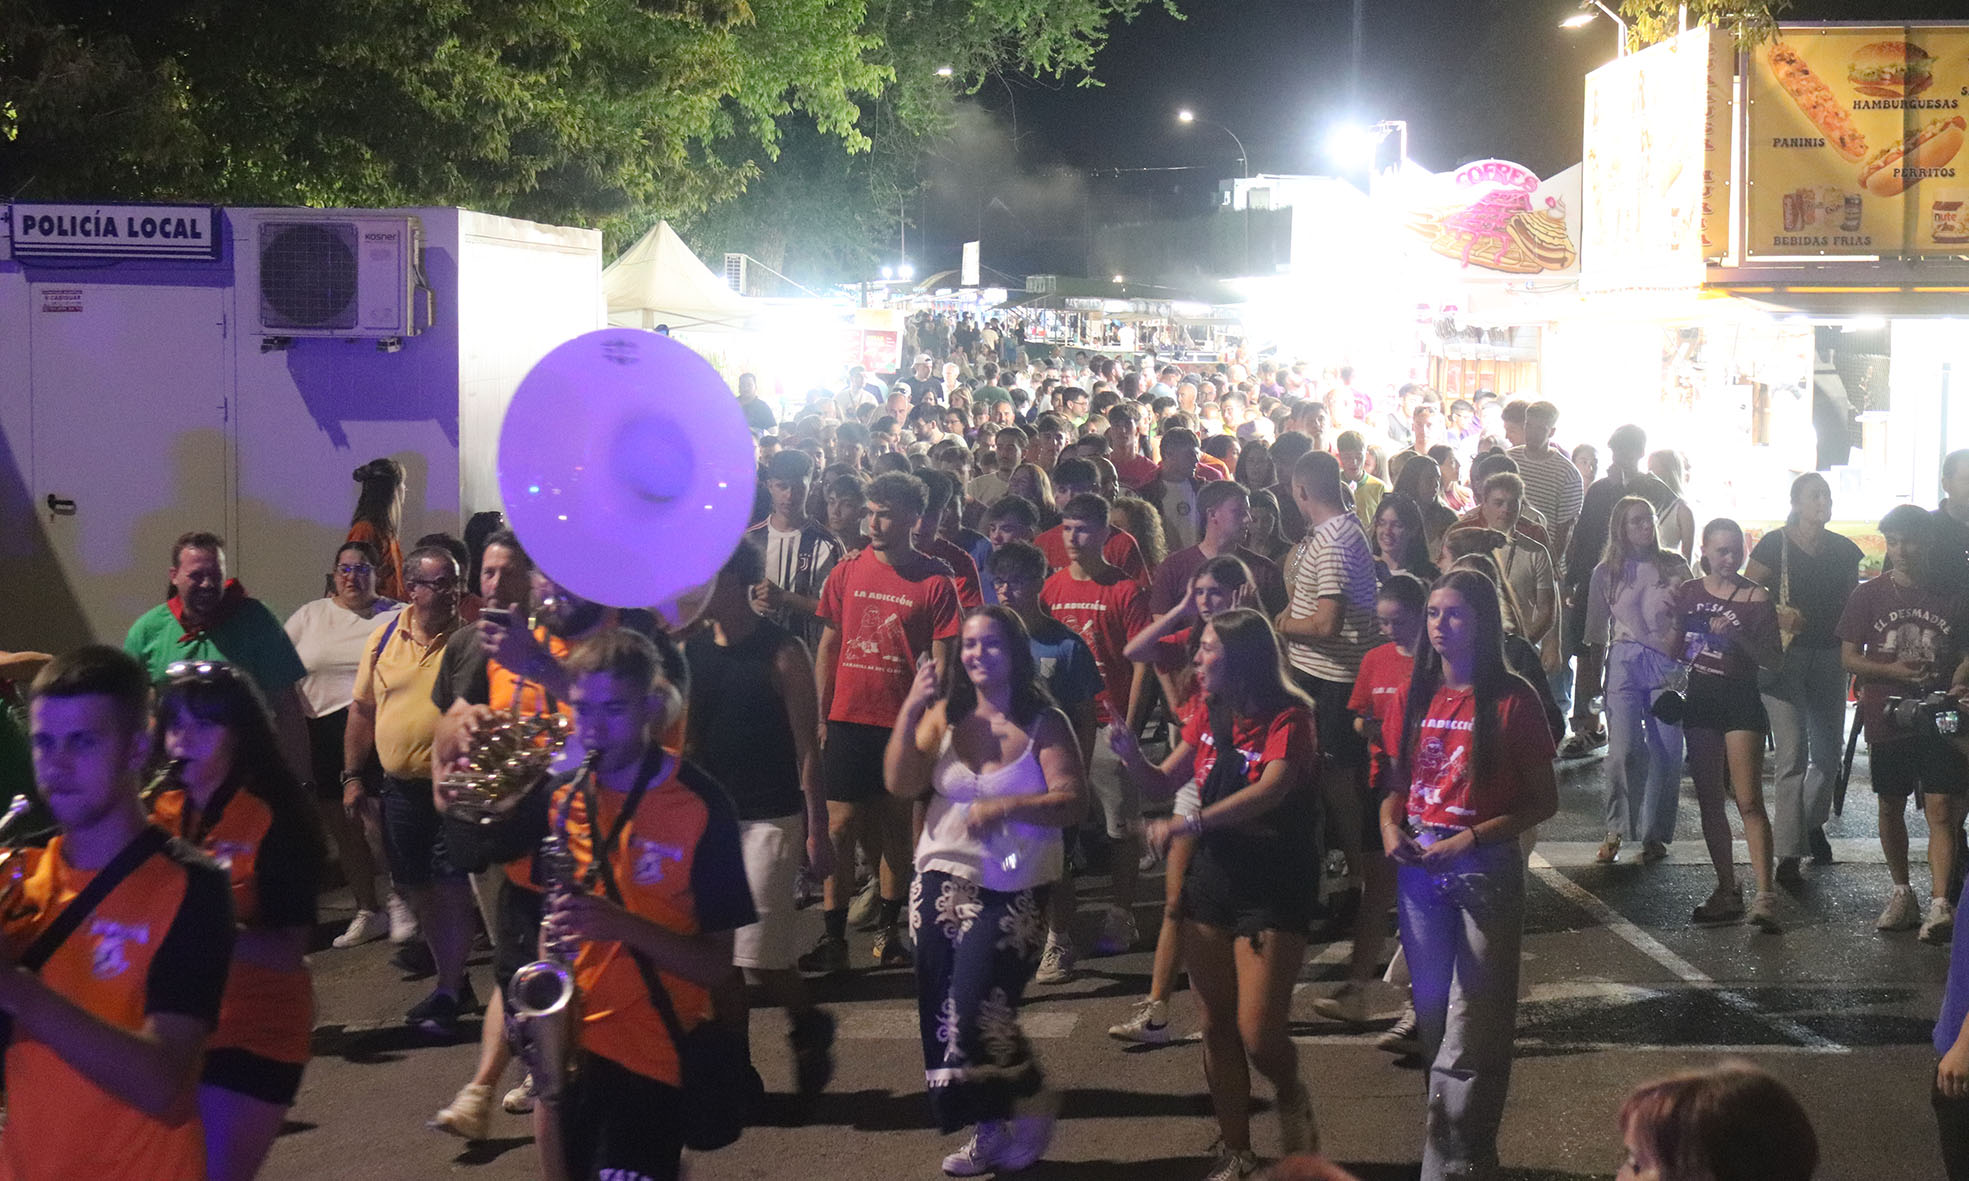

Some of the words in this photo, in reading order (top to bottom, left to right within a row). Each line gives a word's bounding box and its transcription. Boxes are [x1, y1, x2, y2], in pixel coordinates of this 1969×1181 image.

[1852, 99, 1958, 110] HAMBURGUESAS
[1772, 137, 1825, 148] PANINIS
[1893, 167, 1956, 178] PERRITOS
[22, 209, 119, 237] POLICÍA
[127, 217, 202, 239] LOCAL
[1773, 236, 1828, 246] BEBIDAS
[1833, 236, 1872, 246] FRIAS
[868, 592, 913, 607] ADICCIÓN
[1051, 603, 1062, 611] LA
[1063, 600, 1107, 611] ADICCIÓN
[1873, 619, 1888, 632] EL
[1889, 608, 1952, 635] DESMADRE
[1427, 718, 1474, 731] ADICCIÓ
